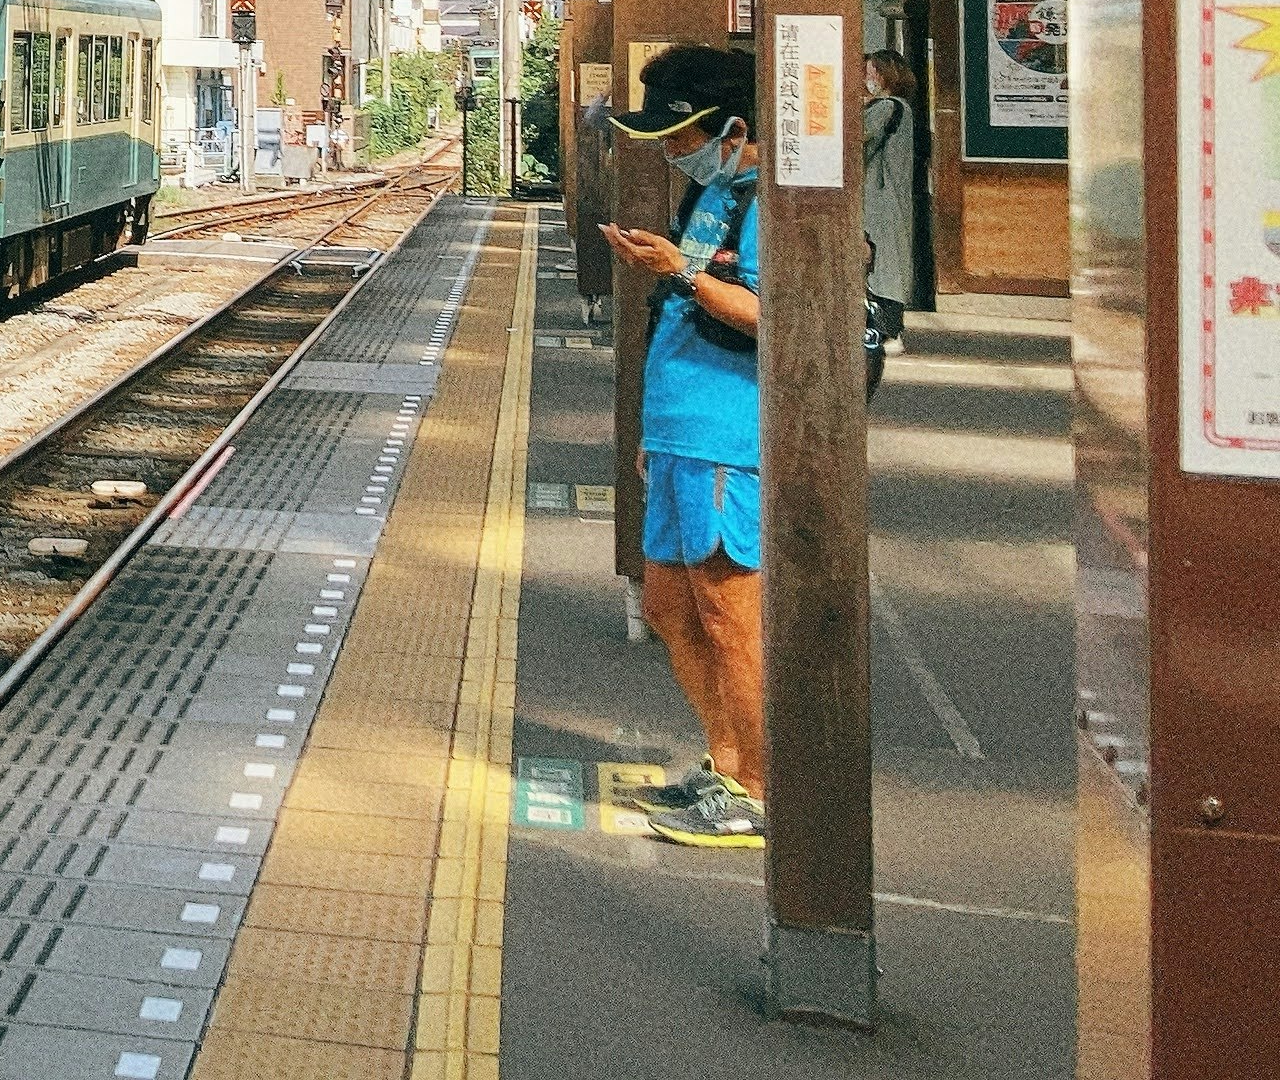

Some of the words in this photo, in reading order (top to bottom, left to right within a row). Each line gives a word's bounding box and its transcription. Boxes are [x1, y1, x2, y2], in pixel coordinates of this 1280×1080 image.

[780, 24, 800, 175] 请在黄线外侧候车
